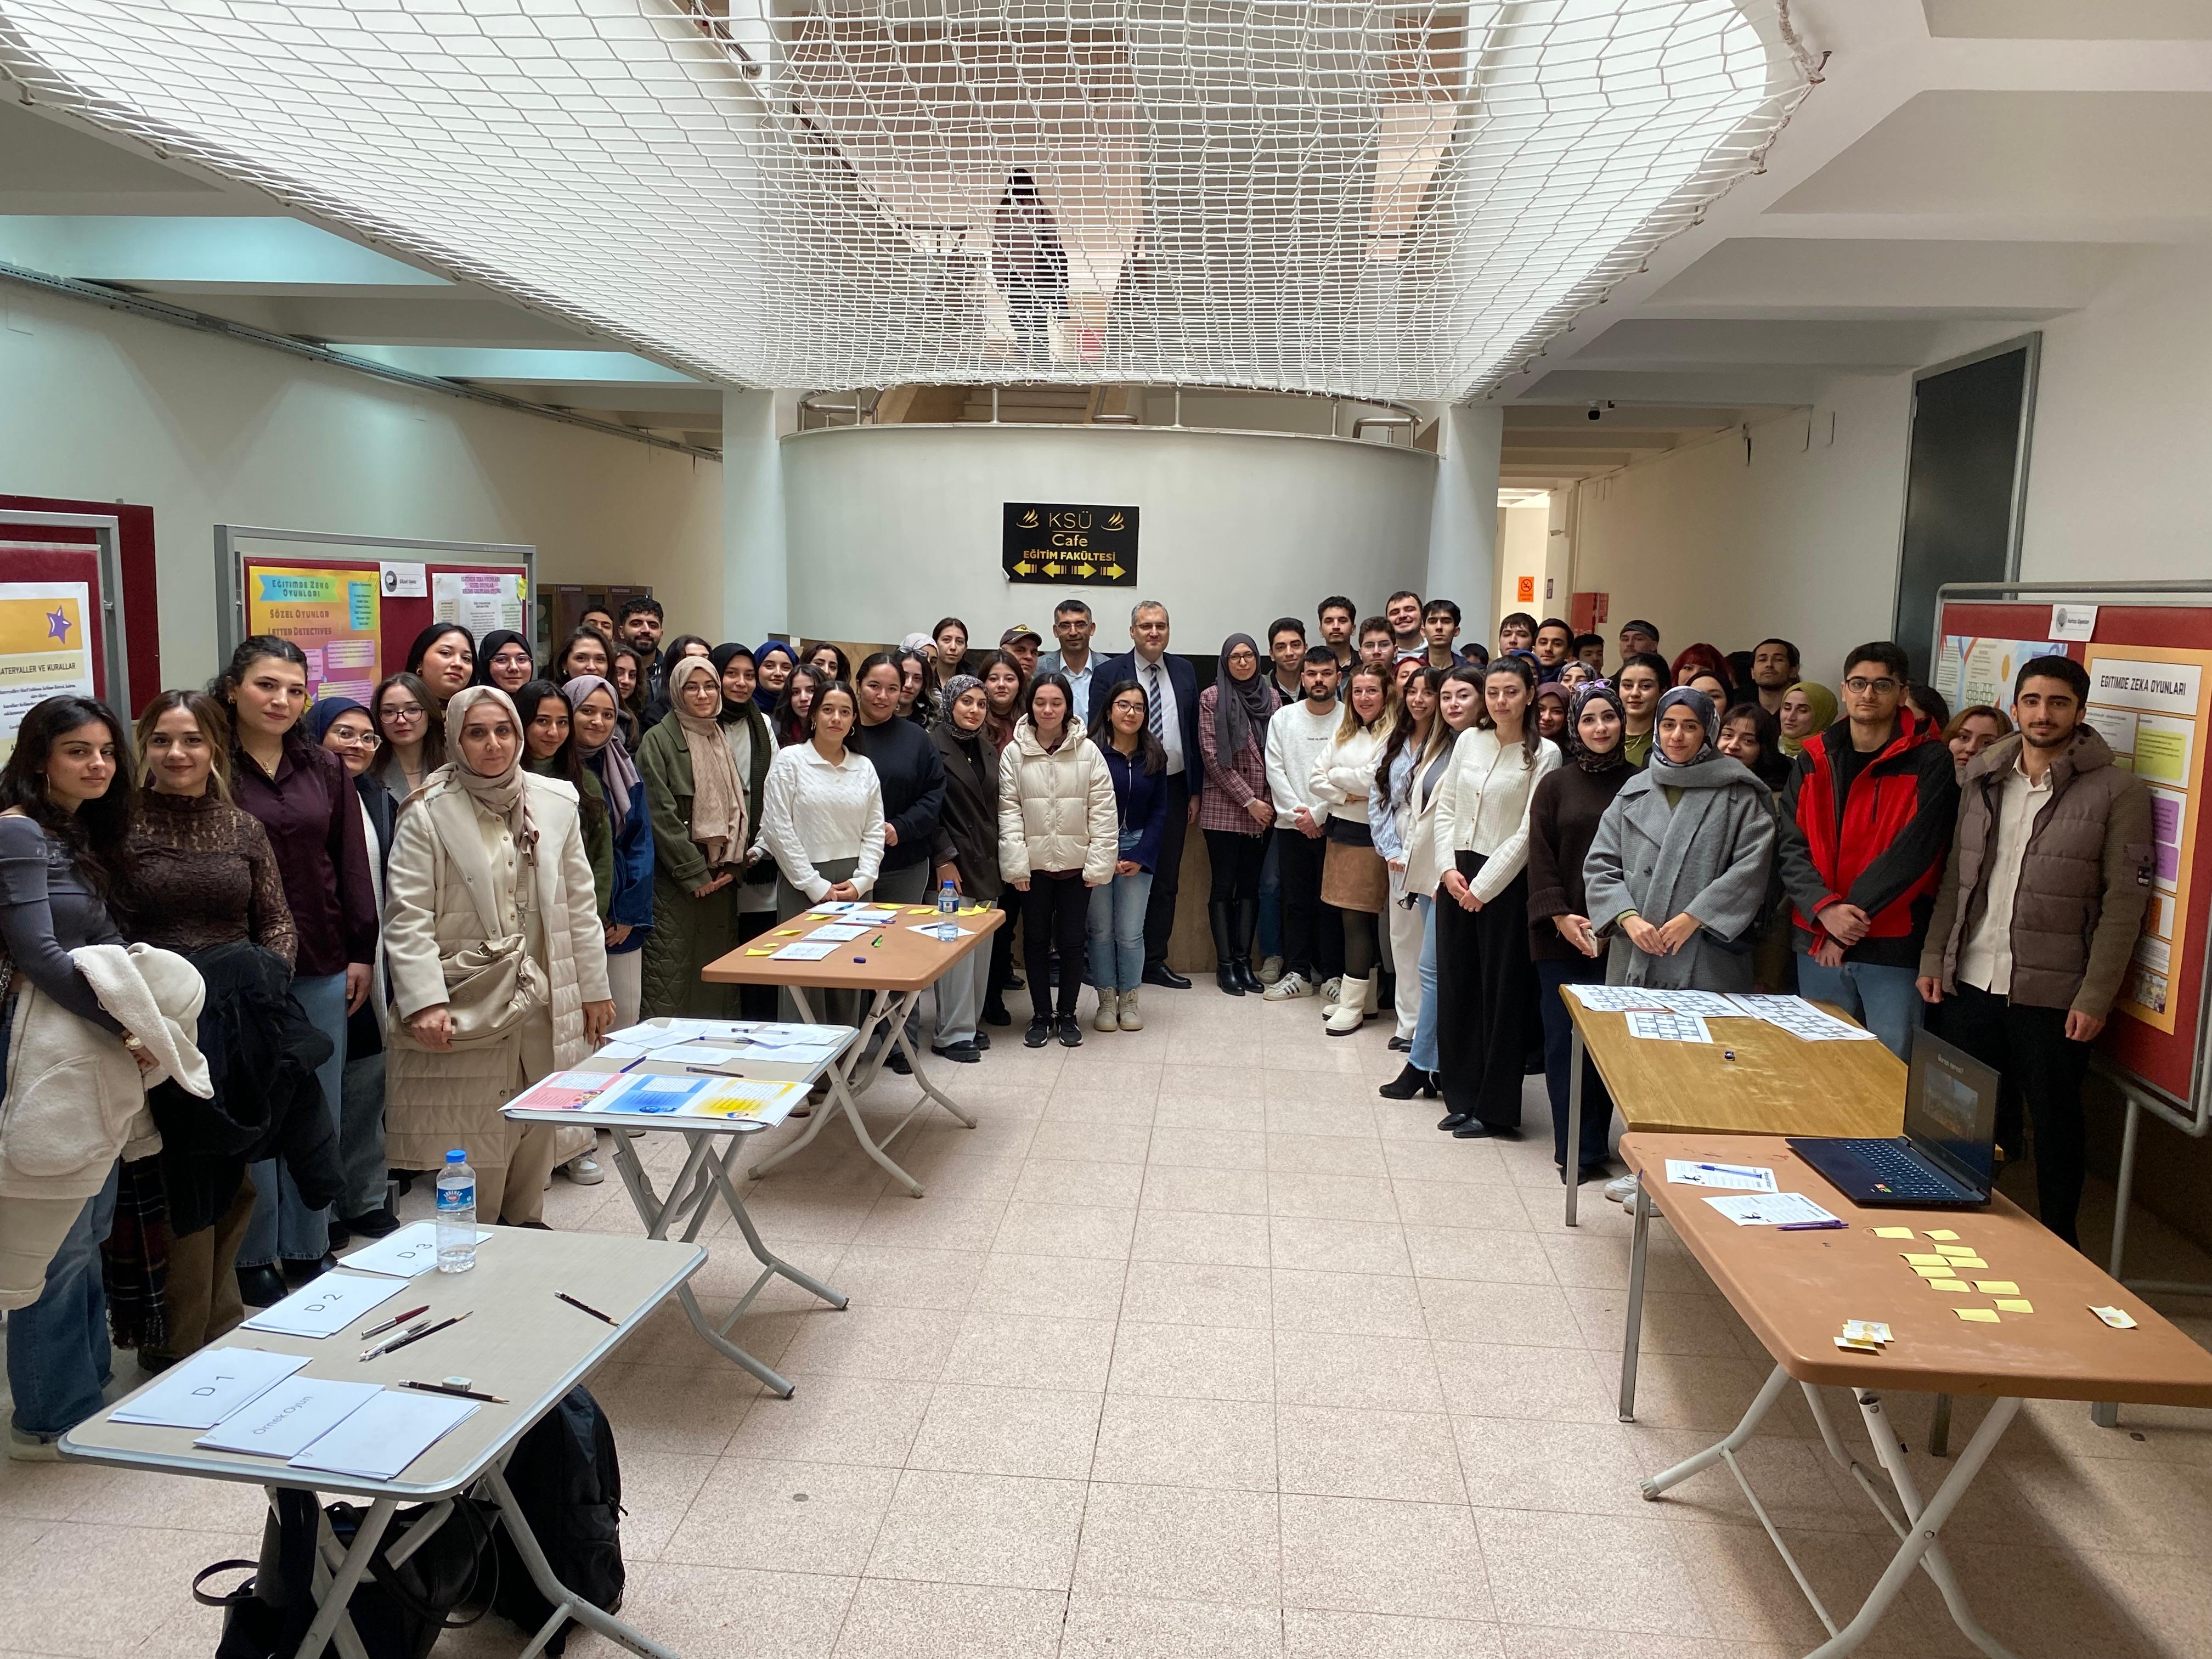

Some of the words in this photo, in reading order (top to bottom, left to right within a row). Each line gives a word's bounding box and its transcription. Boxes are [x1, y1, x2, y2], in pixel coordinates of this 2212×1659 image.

[1049, 511, 1092, 529] KSÜ
[1052, 534, 1088, 547] Cafe
[1023, 549, 1058, 560] EĞİTİM
[1060, 551, 1115, 562] FAKÜLTESİ
[270, 608, 294, 619] SÖZEL
[295, 610, 329, 618] OYUNLAR
[294, 627, 332, 636] DETECTIVES
[0, 665, 37, 675] ATERYALLER
[47, 662, 76, 671] KURALLAR
[2130, 678, 2149, 692] ZEKA
[2151, 680, 2186, 696] OYUNLARI
[191, 1387, 215, 1396] D
[251, 1413, 287, 1435] Örnek
[283, 1395, 313, 1414] Oyun
